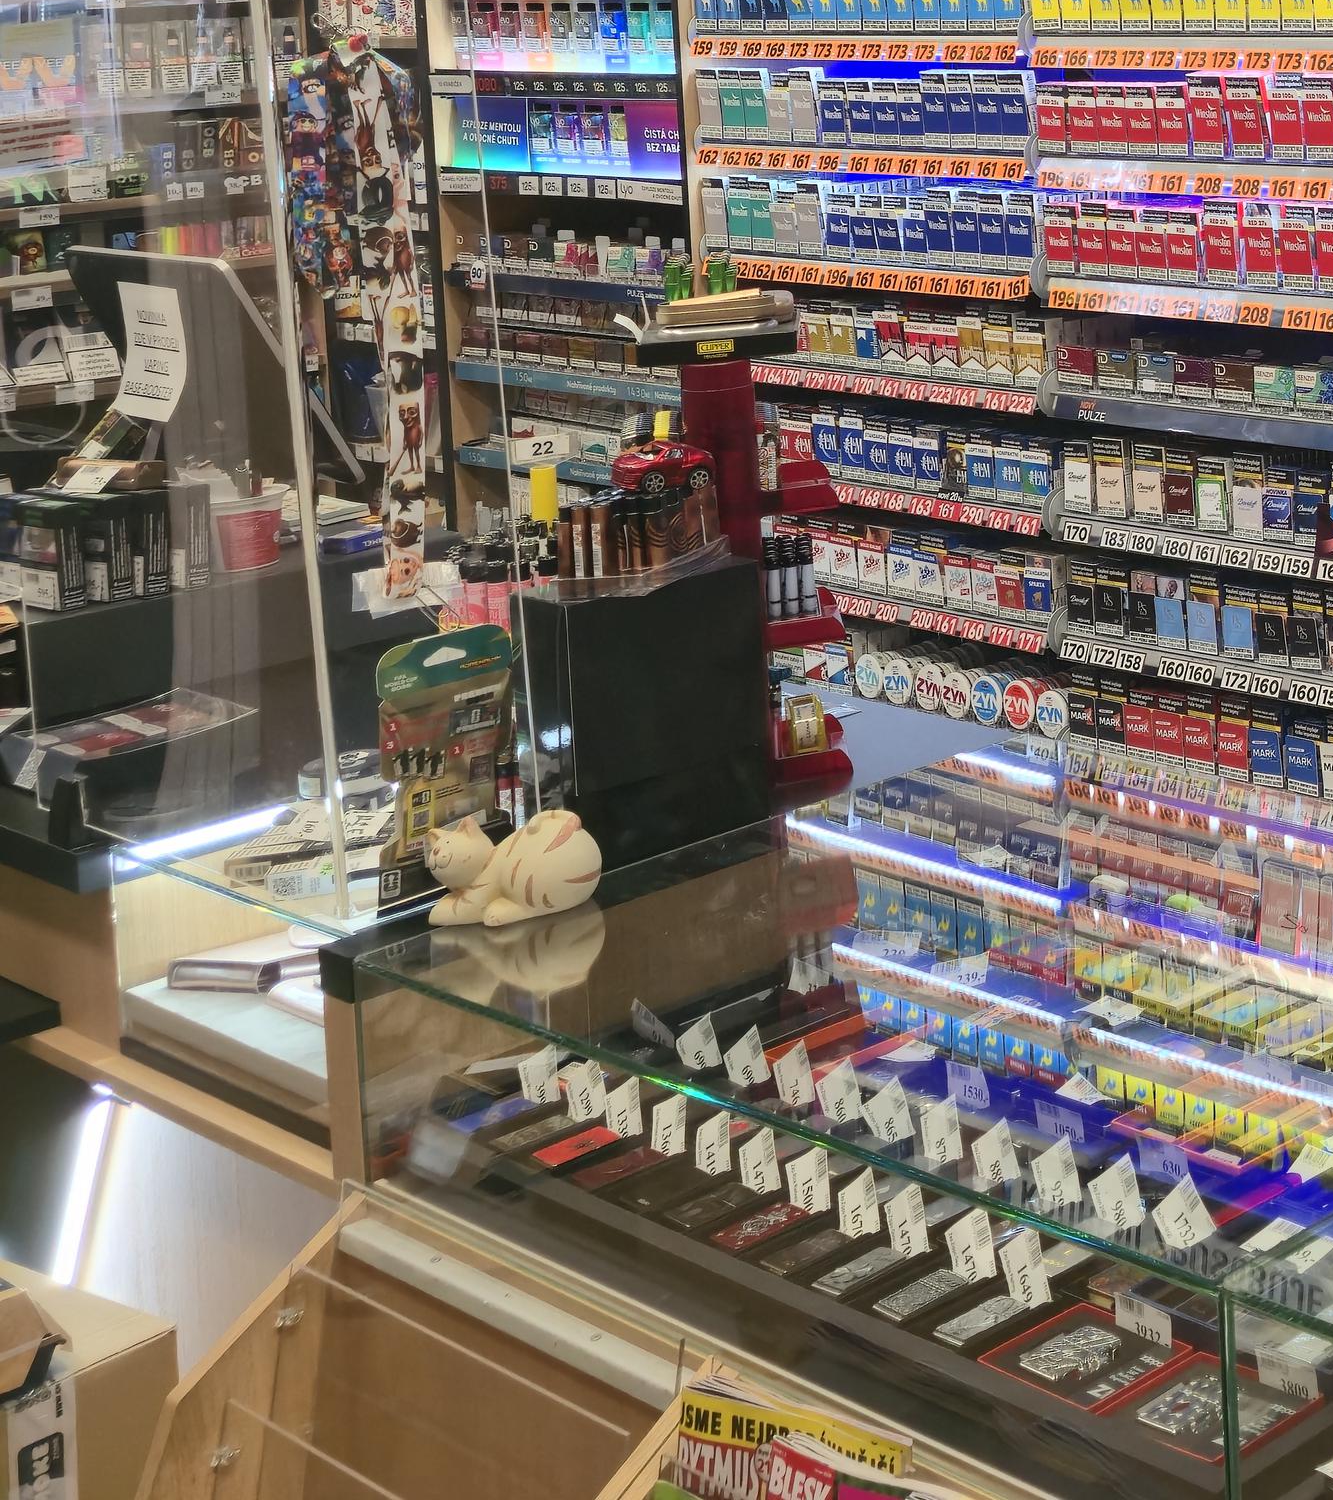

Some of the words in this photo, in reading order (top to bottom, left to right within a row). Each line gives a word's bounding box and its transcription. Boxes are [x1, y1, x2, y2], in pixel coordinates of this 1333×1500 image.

[1195, 177, 1222, 195] 208
[699, 341, 732, 353] CLIPPER
[1078, 409, 1106, 422] PULZE
[531, 439, 554, 456] 22
[959, 507, 983, 524] 290
[1119, 653, 1141, 670] 158
[1038, 707, 1063, 723] ZYN
